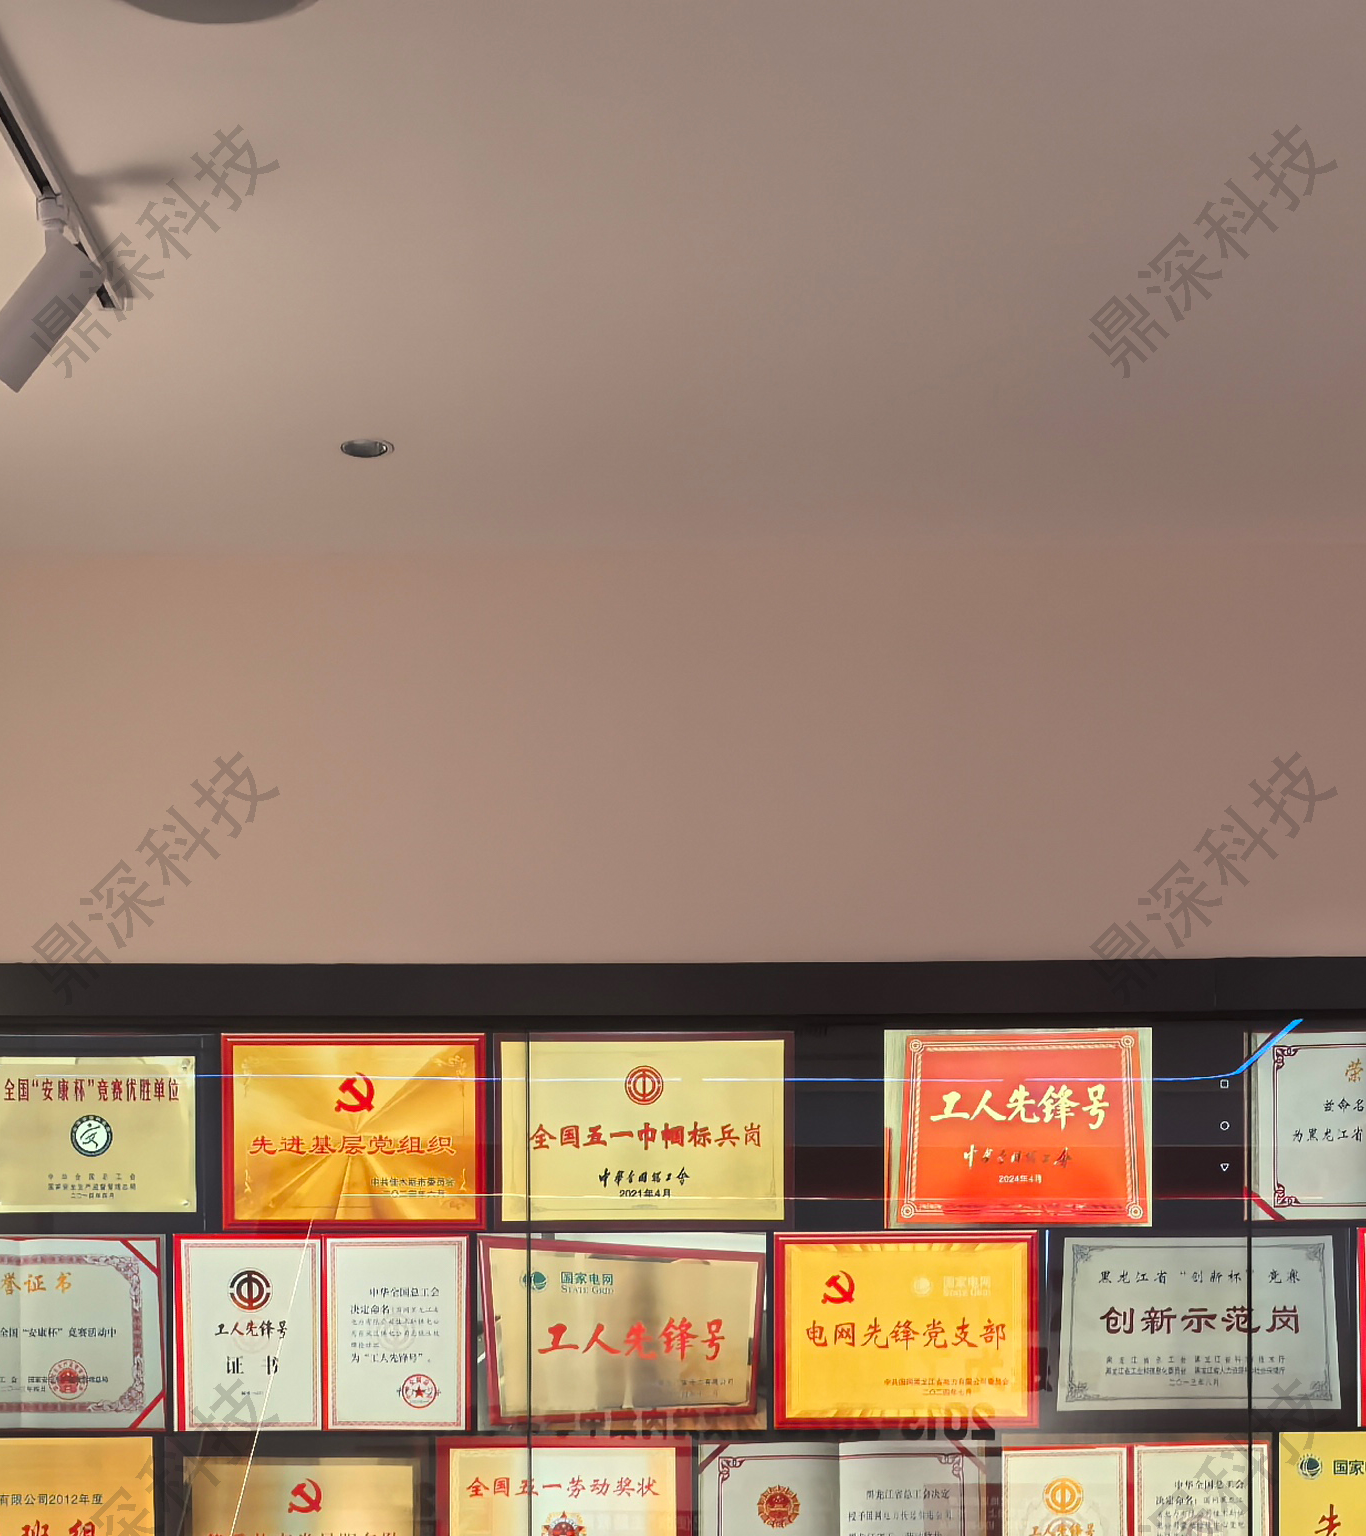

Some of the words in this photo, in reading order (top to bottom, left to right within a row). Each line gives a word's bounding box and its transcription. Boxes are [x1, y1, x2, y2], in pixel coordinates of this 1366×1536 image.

[3, 1076, 181, 1102] 全国“安康杯”竞赛优胜单位
[929, 1083, 1110, 1131] 工人先锋号
[248, 1134, 457, 1156] 先进基层党组织
[529, 1121, 762, 1150] 全国五一巾帼标兵岗
[619, 1189, 672, 1198] 2021年4月
[560, 1272, 614, 1286] 国家电网
[214, 1320, 288, 1340] 工人先锋号
[1099, 1305, 1301, 1334] 创新示范岗
[537, 1316, 726, 1362] 工人先锋号
[805, 1316, 1007, 1350] 电网先锋党支部
[226, 1355, 279, 1376] 证书
[466, 1475, 660, 1498] 全国五一劳动奖状
